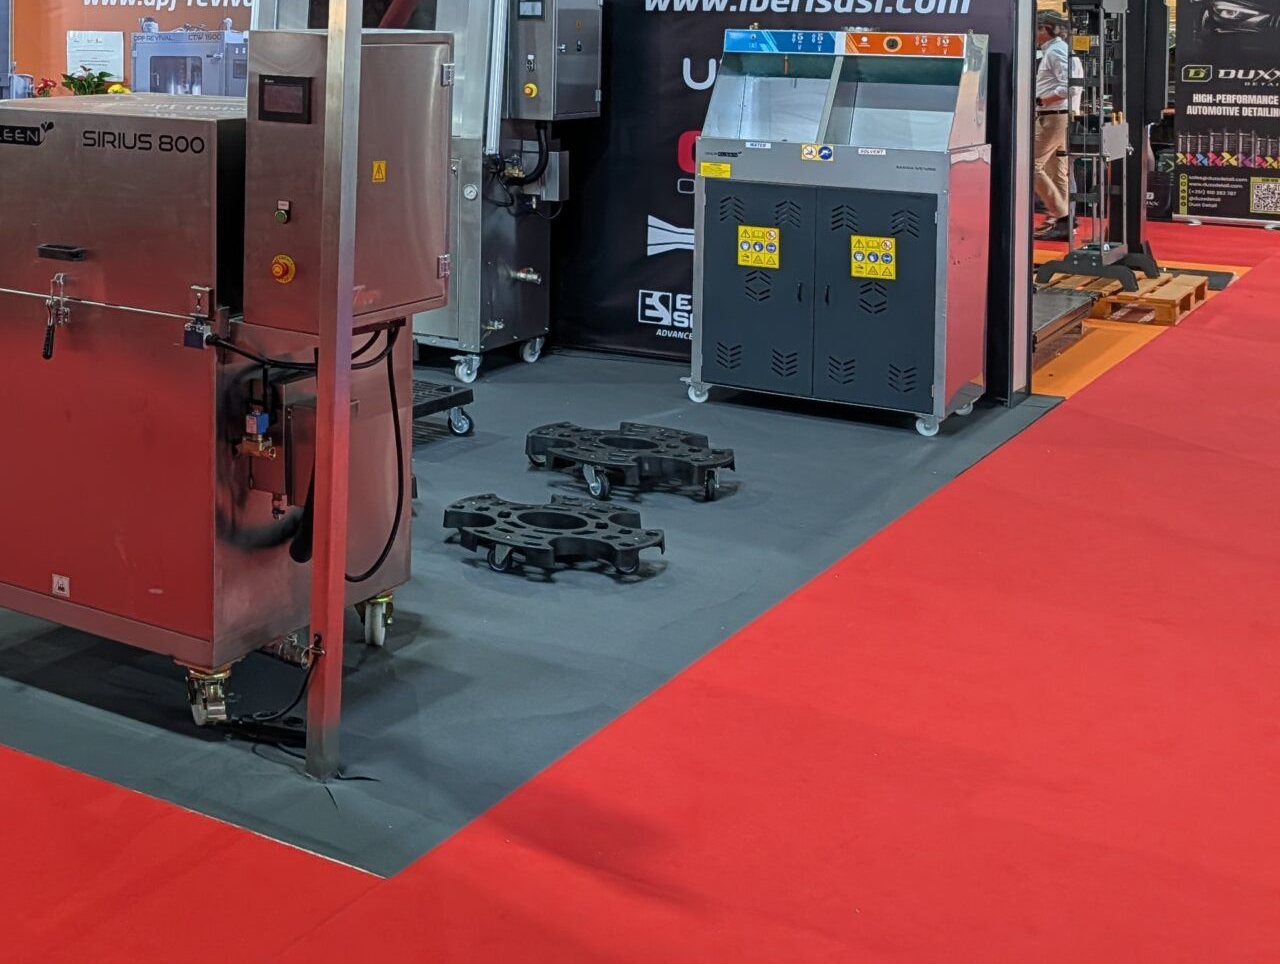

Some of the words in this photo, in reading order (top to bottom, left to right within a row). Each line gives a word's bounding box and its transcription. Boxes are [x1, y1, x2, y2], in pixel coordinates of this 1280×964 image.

[1193, 93, 1279, 105] HIGH-PERFORMANCE
[1186, 105, 1239, 116] AUTOMOTIVE
[1242, 106, 1280, 117] DETAILIN
[82, 130, 153, 150] SIRIUS
[158, 135, 204, 154] 800
